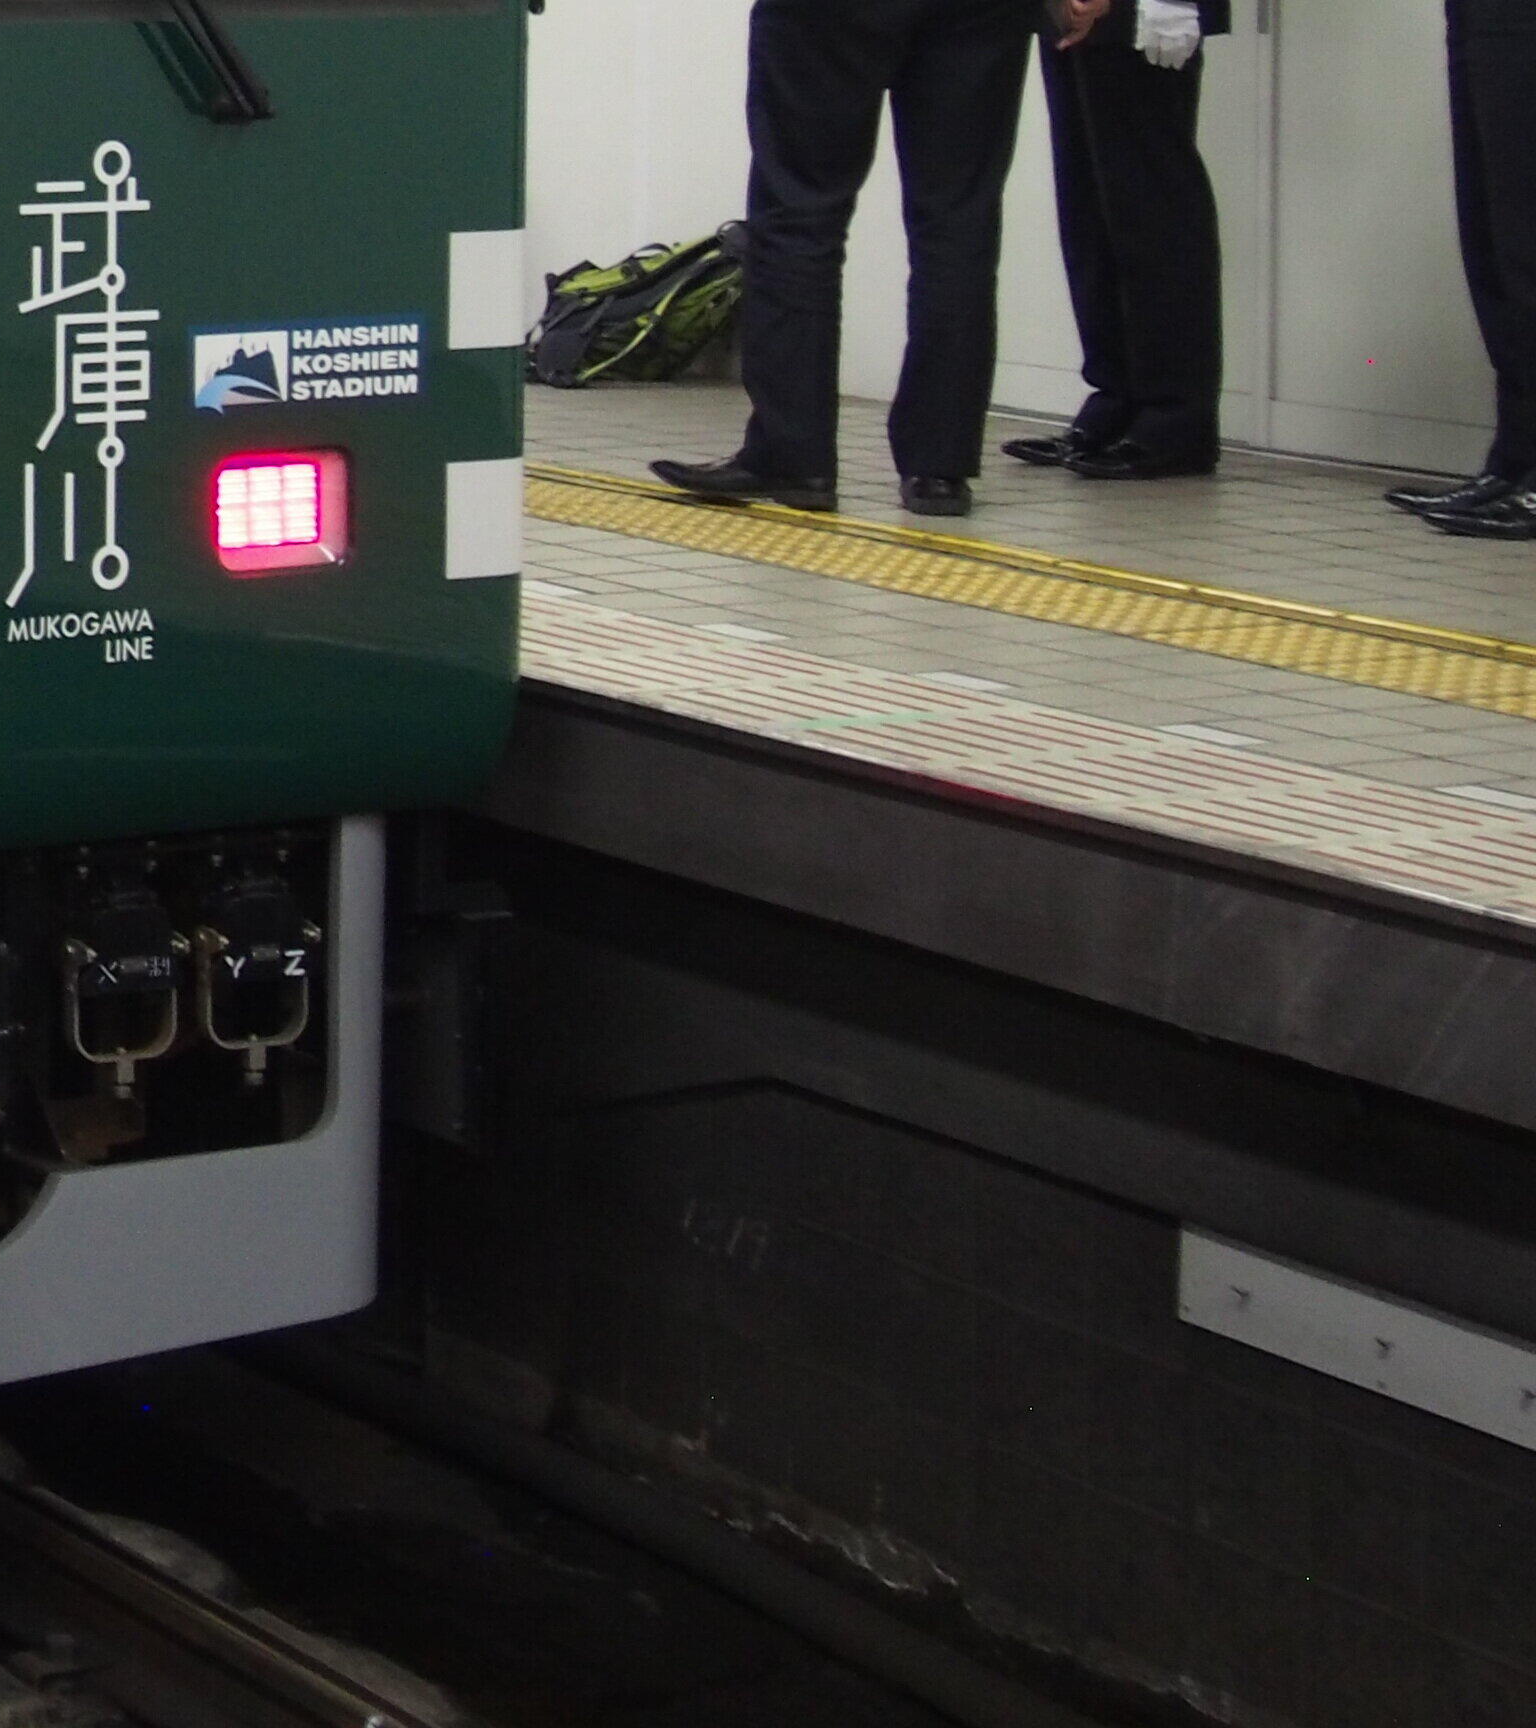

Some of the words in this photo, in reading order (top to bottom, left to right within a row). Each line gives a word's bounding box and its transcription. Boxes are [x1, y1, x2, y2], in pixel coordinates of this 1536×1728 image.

[292, 323, 419, 350] HANSHIN
[6, 140, 160, 608] 武庫川
[291, 349, 419, 375] KOSHIEN
[291, 374, 418, 401] STADIUM
[7, 608, 154, 643] MUKOGAWA
[105, 635, 154, 663] LINE
[97, 960, 119, 984] X
[224, 955, 247, 979] Y
[283, 948, 306, 976] Z
